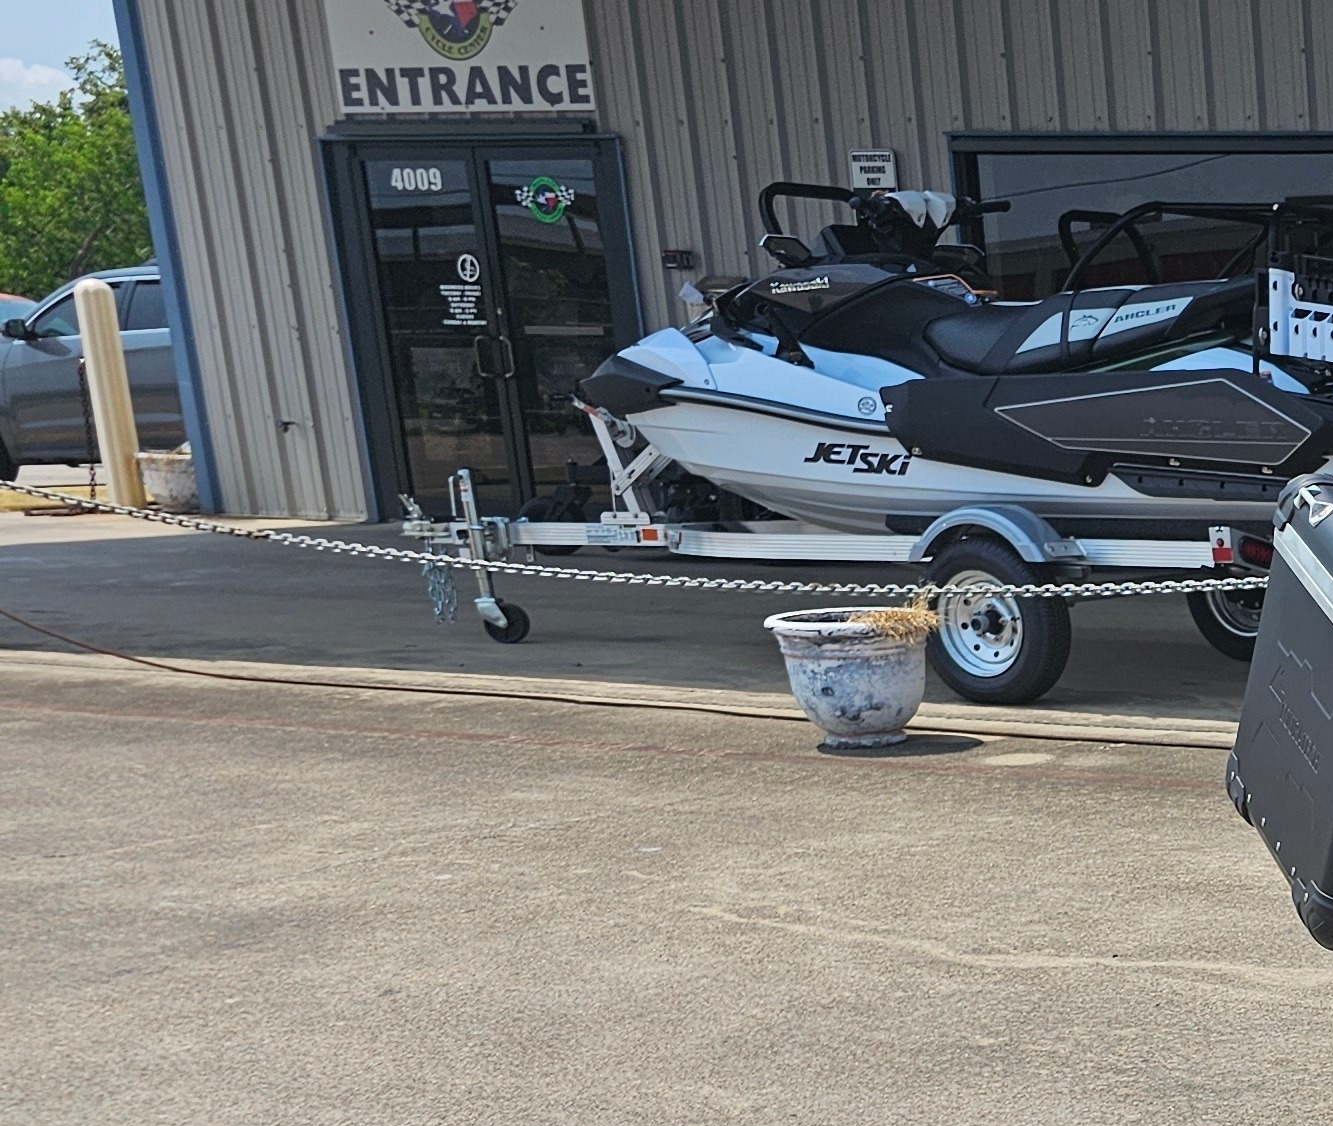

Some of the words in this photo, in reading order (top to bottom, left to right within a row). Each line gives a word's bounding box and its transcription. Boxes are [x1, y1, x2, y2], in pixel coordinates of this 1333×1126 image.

[424, 26, 455, 55] CYCLE
[457, 25, 488, 55] CENTER
[338, 64, 591, 107] ENTRANCE
[852, 154, 891, 162] MOTORCYCLE
[859, 165, 886, 174] PARKING
[391, 168, 442, 191] 4009
[769, 276, 830, 295] Kawasaki
[1114, 304, 1176, 323] ANGLER
